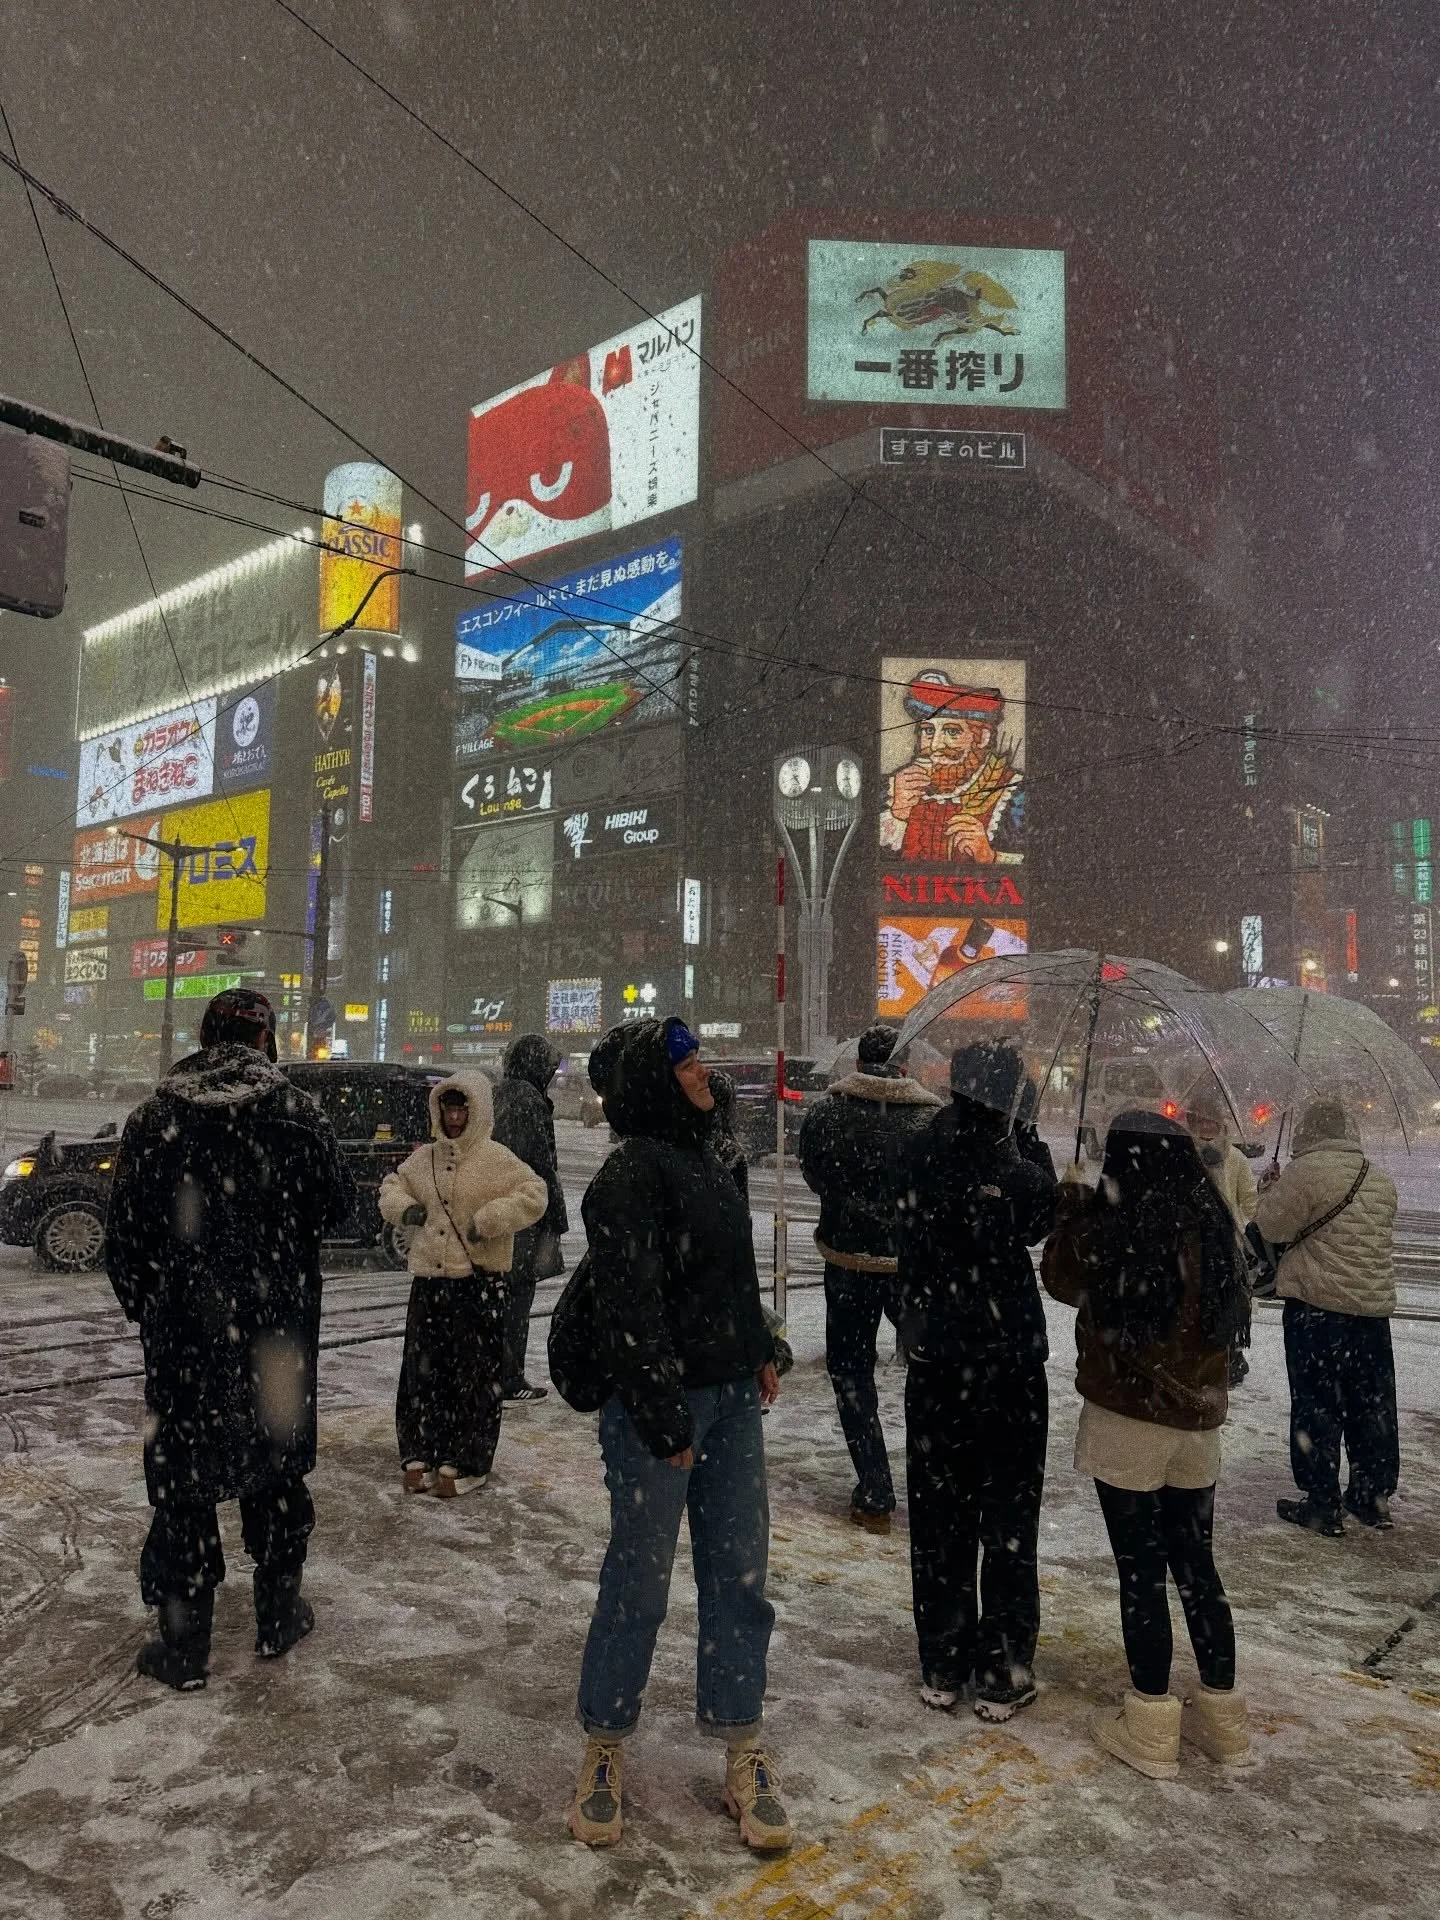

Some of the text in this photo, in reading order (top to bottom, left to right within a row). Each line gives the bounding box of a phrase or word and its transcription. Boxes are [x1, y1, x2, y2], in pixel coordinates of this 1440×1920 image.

[637, 319, 695, 365] マルハン
[854, 349, 1024, 393] 一番搾り
[890, 438, 1016, 459] すすきのビル
[141, 719, 193, 754] カラオケ
[462, 736, 495, 754] VILLAGE
[132, 752, 199, 806] まねきねこ
[604, 809, 649, 830] HIBIKI
[623, 829, 660, 845] Group
[881, 874, 1024, 905] NIKKA
[878, 932, 889, 1000] FRONTIER
[891, 932, 903, 977] NIKKA
